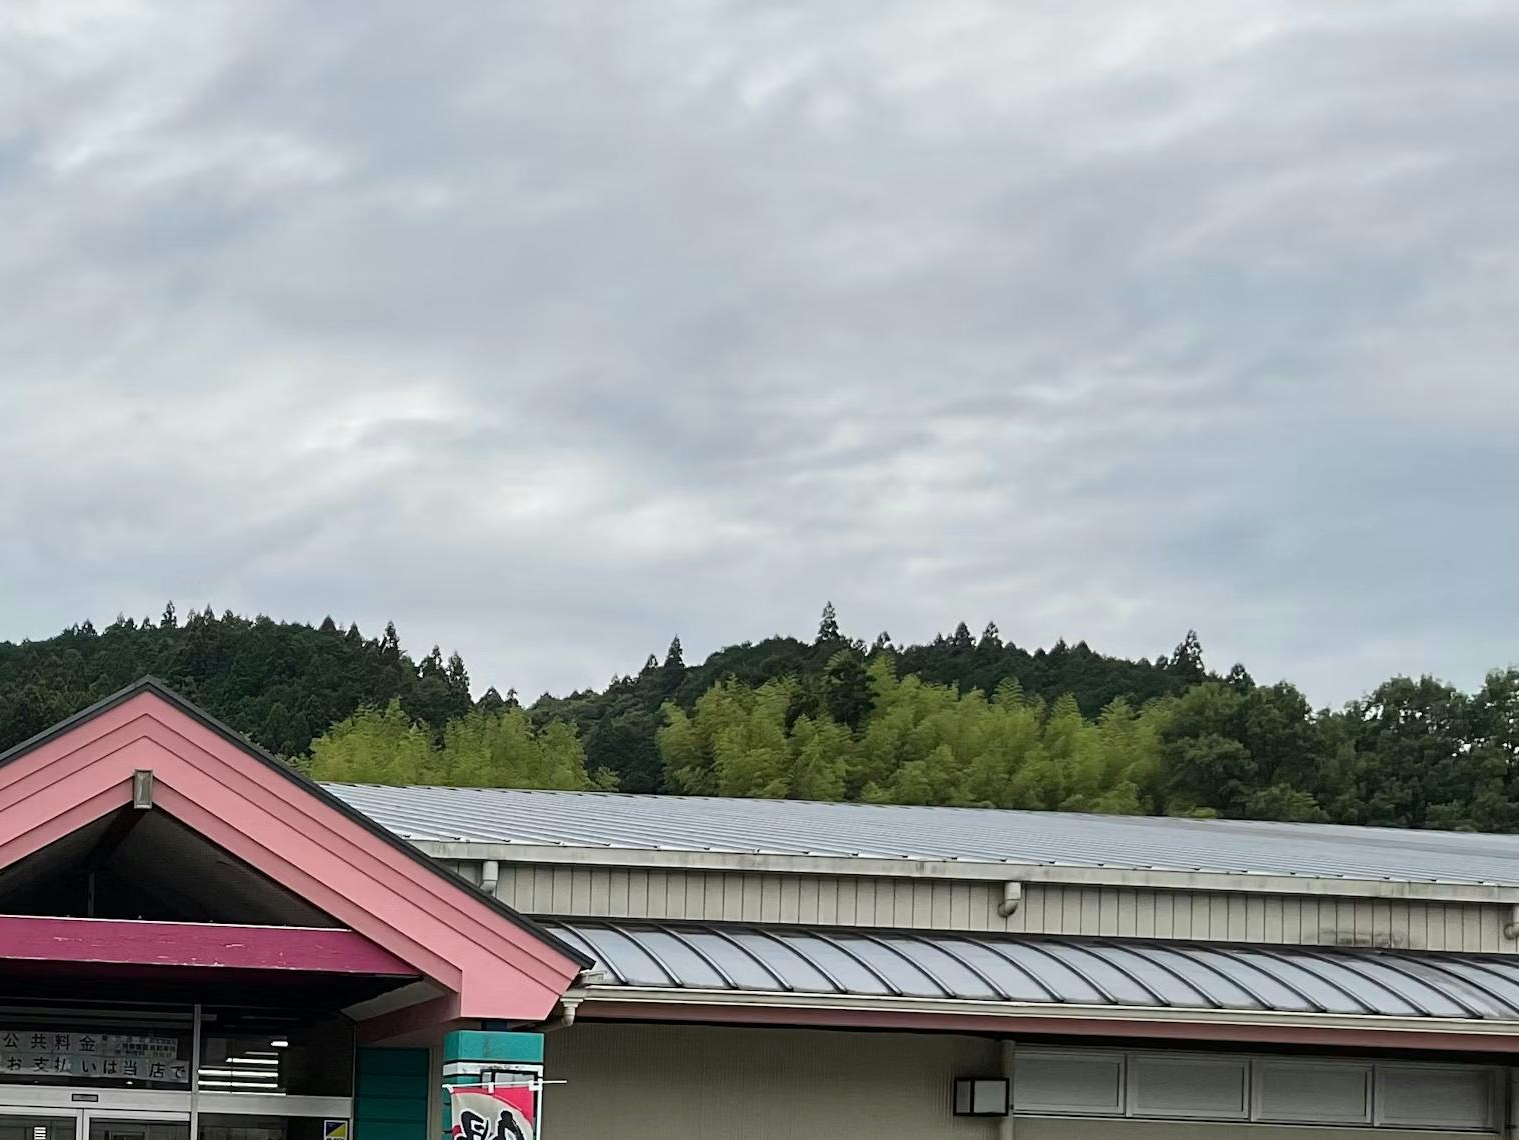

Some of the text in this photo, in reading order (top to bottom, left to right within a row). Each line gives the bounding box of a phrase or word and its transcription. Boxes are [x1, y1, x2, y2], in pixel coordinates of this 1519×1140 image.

[3, 1033, 96, 1052] 公共料金
[7, 1056, 186, 1078] お支払いは当店で
